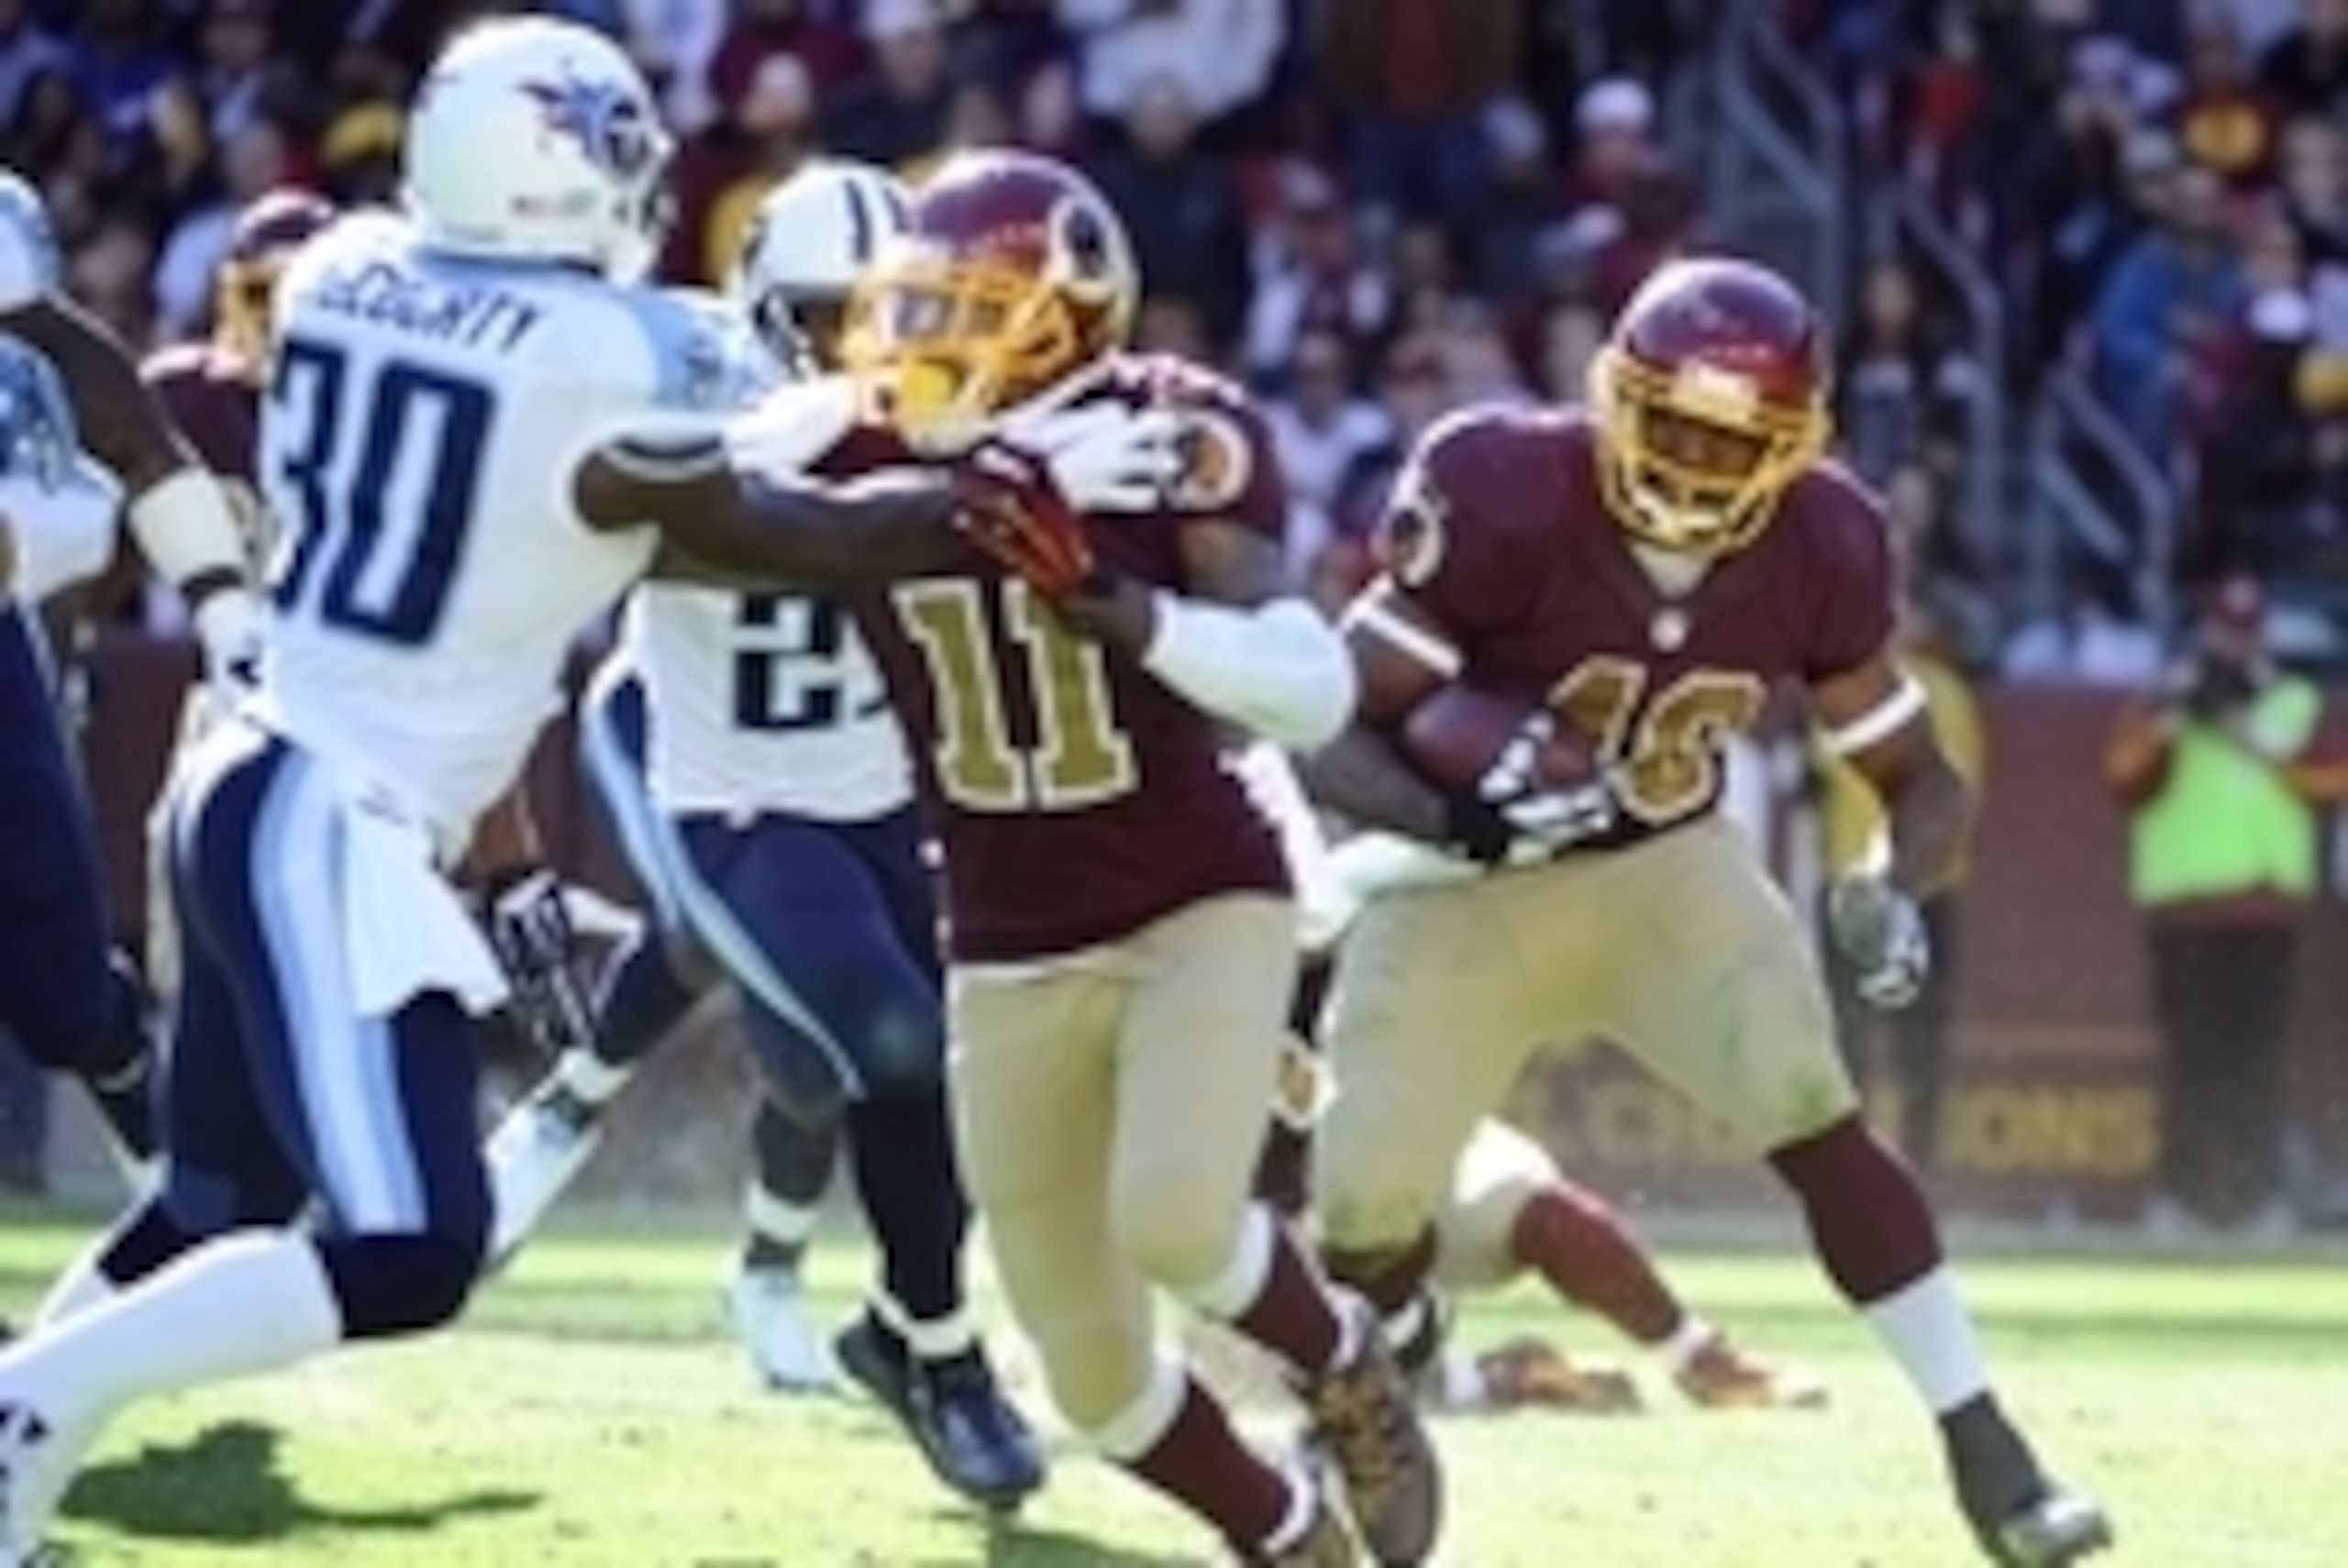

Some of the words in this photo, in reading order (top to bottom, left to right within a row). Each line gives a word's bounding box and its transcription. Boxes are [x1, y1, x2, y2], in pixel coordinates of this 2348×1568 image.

[270, 336, 497, 647] 30
[734, 591, 892, 731] 2
[888, 576, 1140, 812] 11
